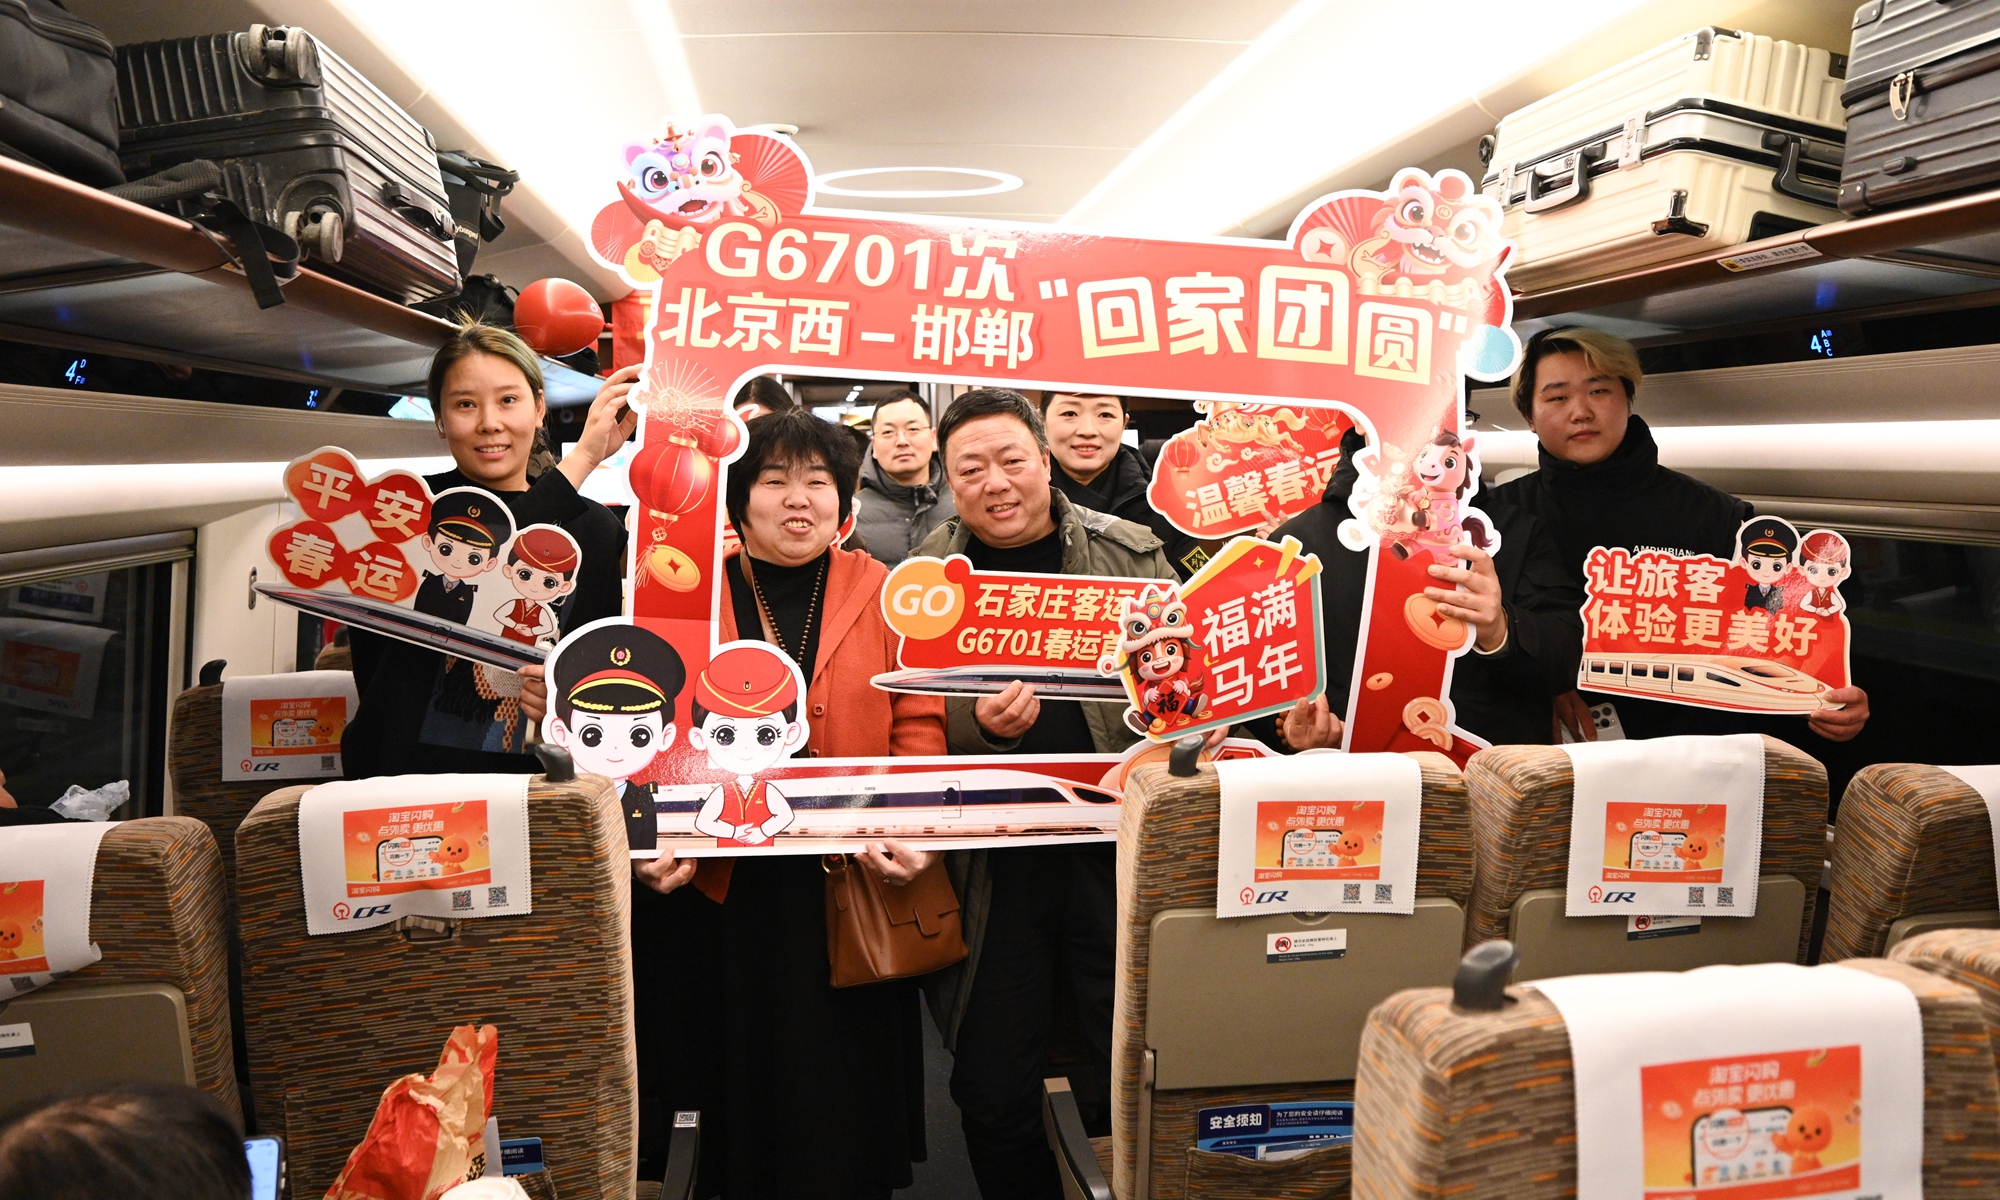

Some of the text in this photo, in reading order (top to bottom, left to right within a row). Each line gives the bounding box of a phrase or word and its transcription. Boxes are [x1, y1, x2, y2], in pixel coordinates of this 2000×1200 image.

[705, 222, 1018, 301] G6701次
[1810, 334, 1822, 353] 4
[1823, 339, 1831, 348] B
[1826, 348, 1833, 357] C
[65, 360, 78, 382] 4
[1185, 447, 1341, 529] 温馨春运
[302, 462, 424, 538] 平安
[284, 531, 403, 601] 春运
[1592, 554, 1726, 604] 让旅客
[892, 583, 956, 617] GO
[1588, 598, 1818, 656] 体验更美好
[1156, 692, 1180, 714] 福
[388, 809, 434, 823] 淘宝闪购
[1296, 805, 1337, 816] 淘宝闪购
[1643, 807, 1683, 818] 淘宝闪购
[378, 820, 444, 836] 点外卖 更优惠
[1285, 816, 1345, 827] 点外卖 更优惠
[1633, 819, 1690, 829] 点外卖 更优惠
[1709, 1060, 1780, 1085] 淘宝闪购
[1209, 1112, 1262, 1130] 安全须知
[1276, 1109, 1344, 1118] 为了您的安全请仔细阅读
